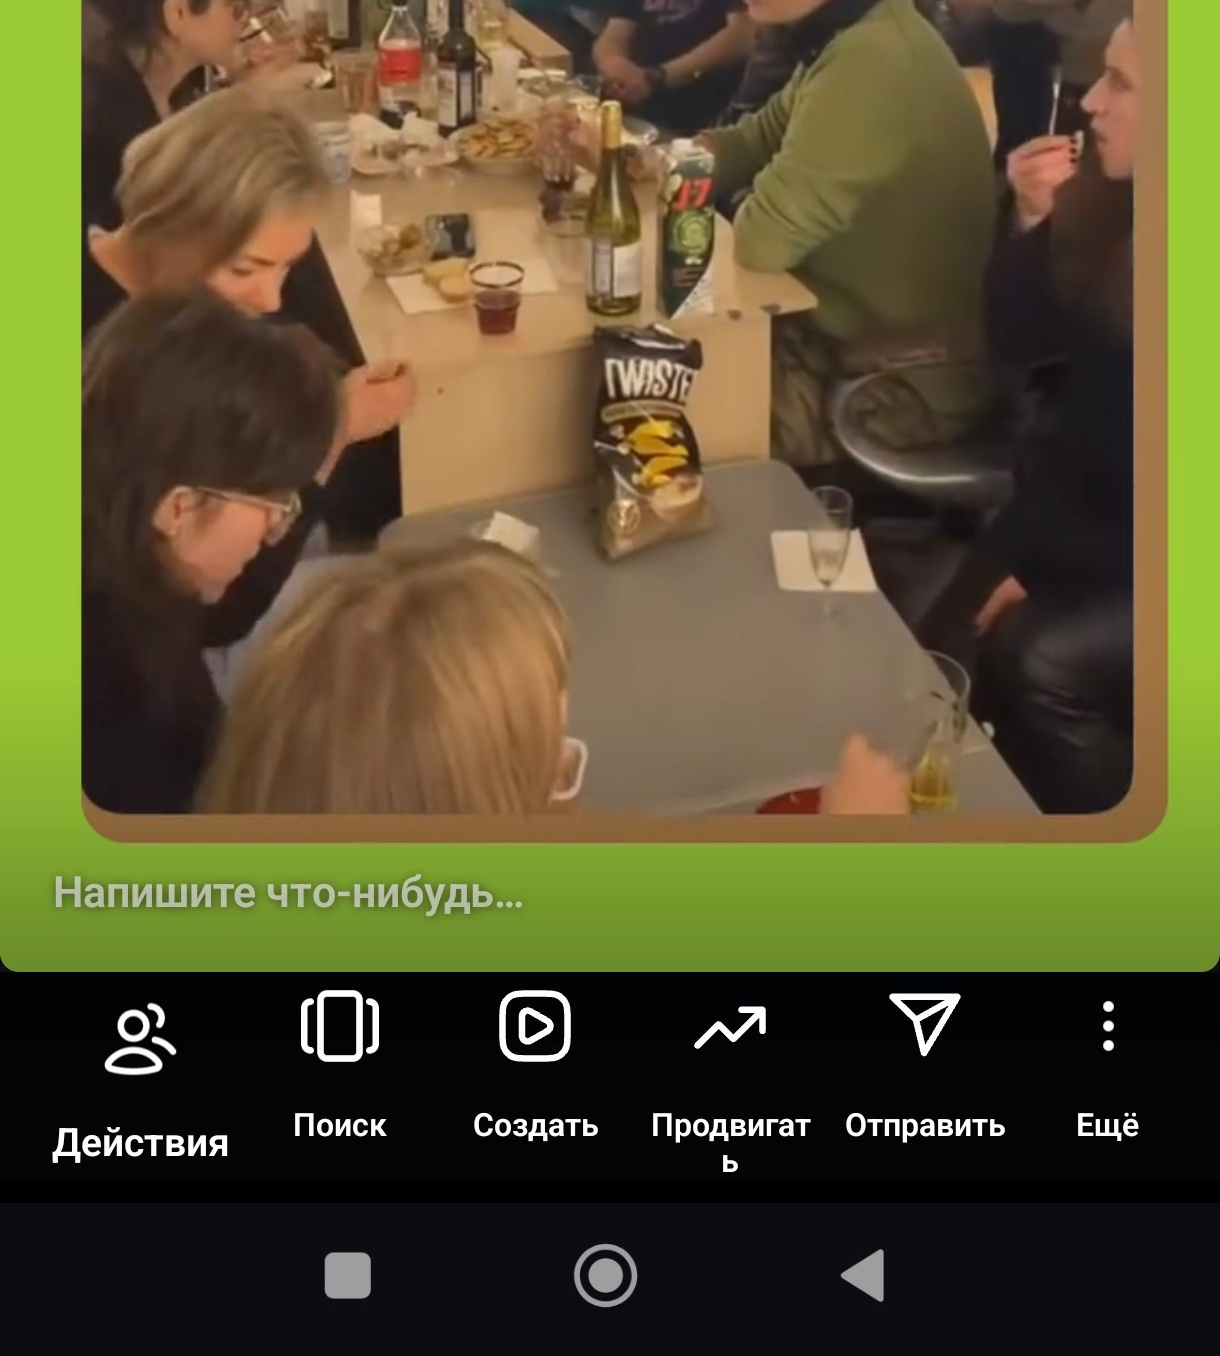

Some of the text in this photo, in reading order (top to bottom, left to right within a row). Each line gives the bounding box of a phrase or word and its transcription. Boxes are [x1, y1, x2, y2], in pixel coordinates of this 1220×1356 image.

[53, 875, 257, 909] Напишите
[293, 1111, 388, 1137] Поиск
[473, 1112, 599, 1142] Создать
[651, 1112, 812, 1144] Продвигат
[845, 1112, 1006, 1144] Отправить
[1076, 1112, 1140, 1143] Ещё
[51, 1125, 229, 1164] Действия
[722, 1154, 740, 1173] ь
